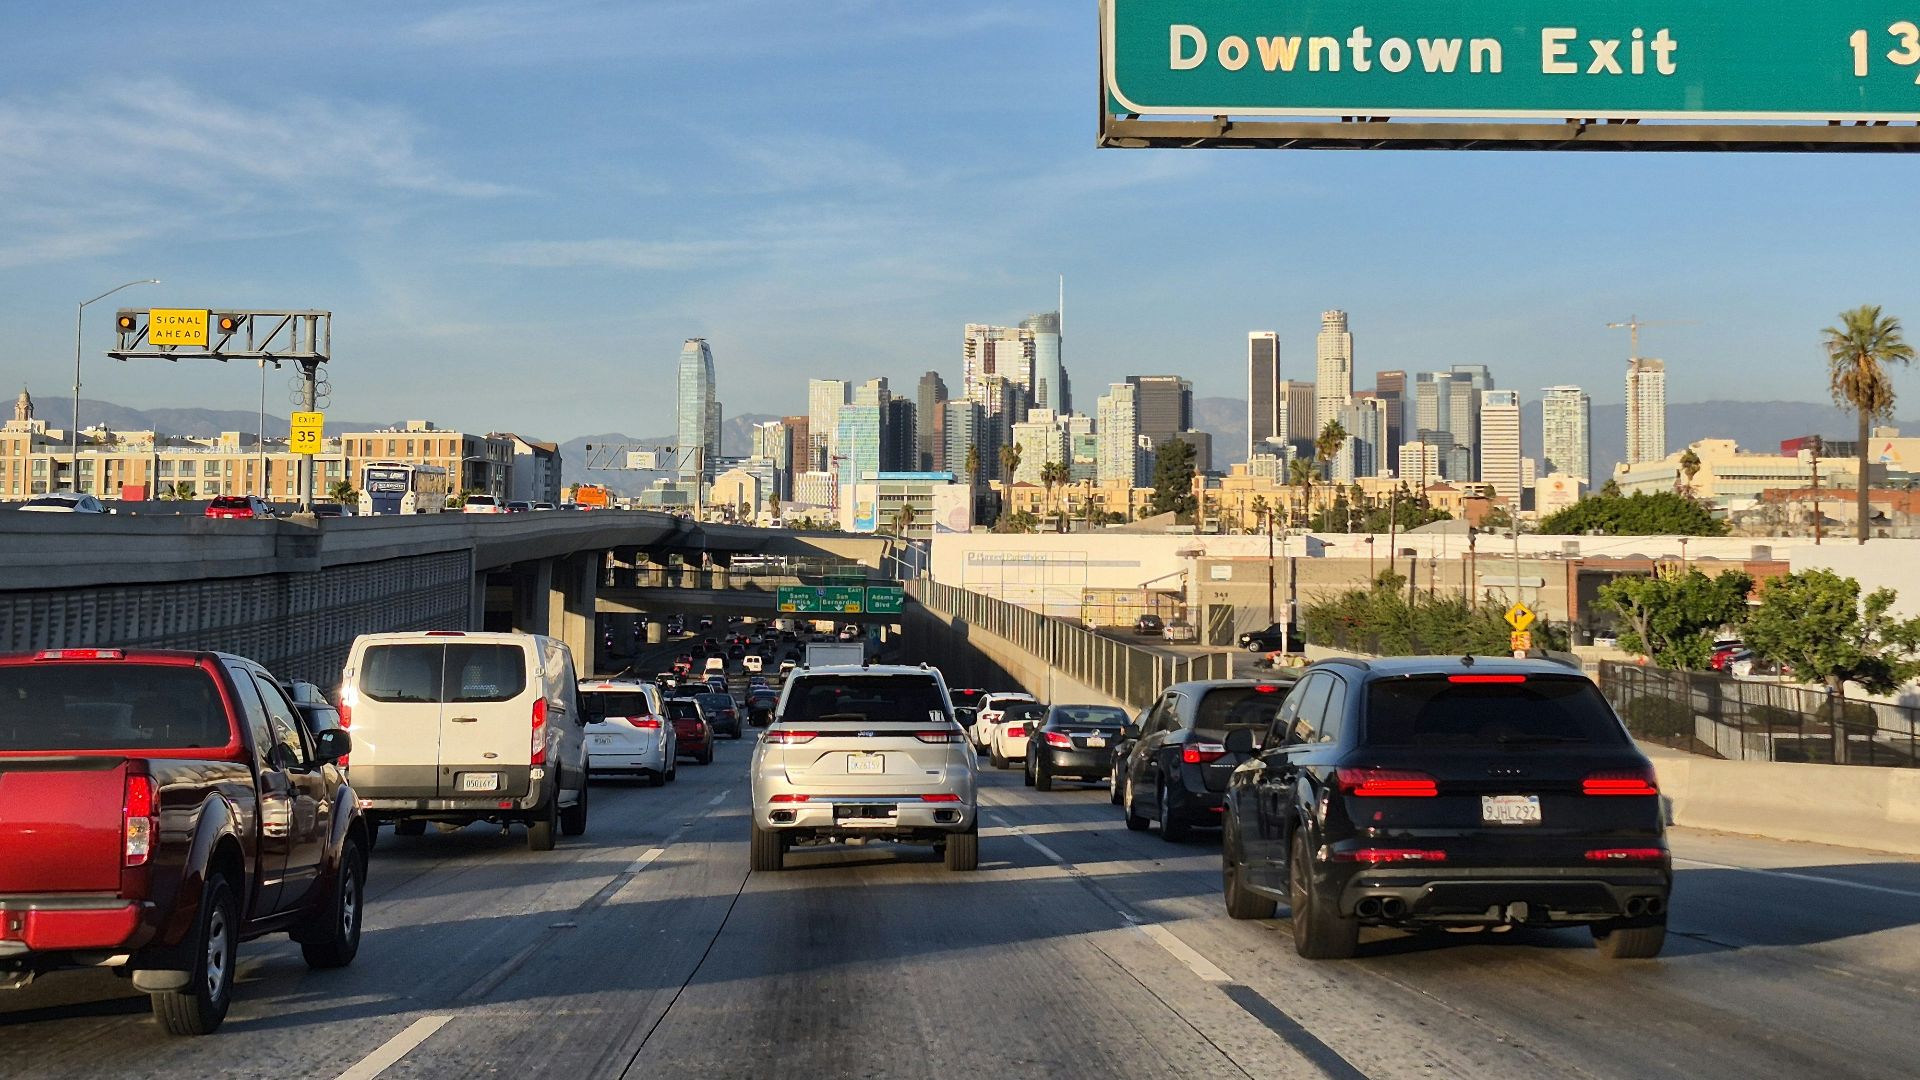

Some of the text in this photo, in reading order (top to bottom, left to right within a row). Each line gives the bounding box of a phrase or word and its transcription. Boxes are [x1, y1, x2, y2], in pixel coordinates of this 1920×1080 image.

[1169, 21, 1920, 84] Downtown Exit 1 3
[156, 316, 201, 325] SIGNAL
[156, 330, 201, 338] AHEAD
[297, 431, 316, 442] 35
